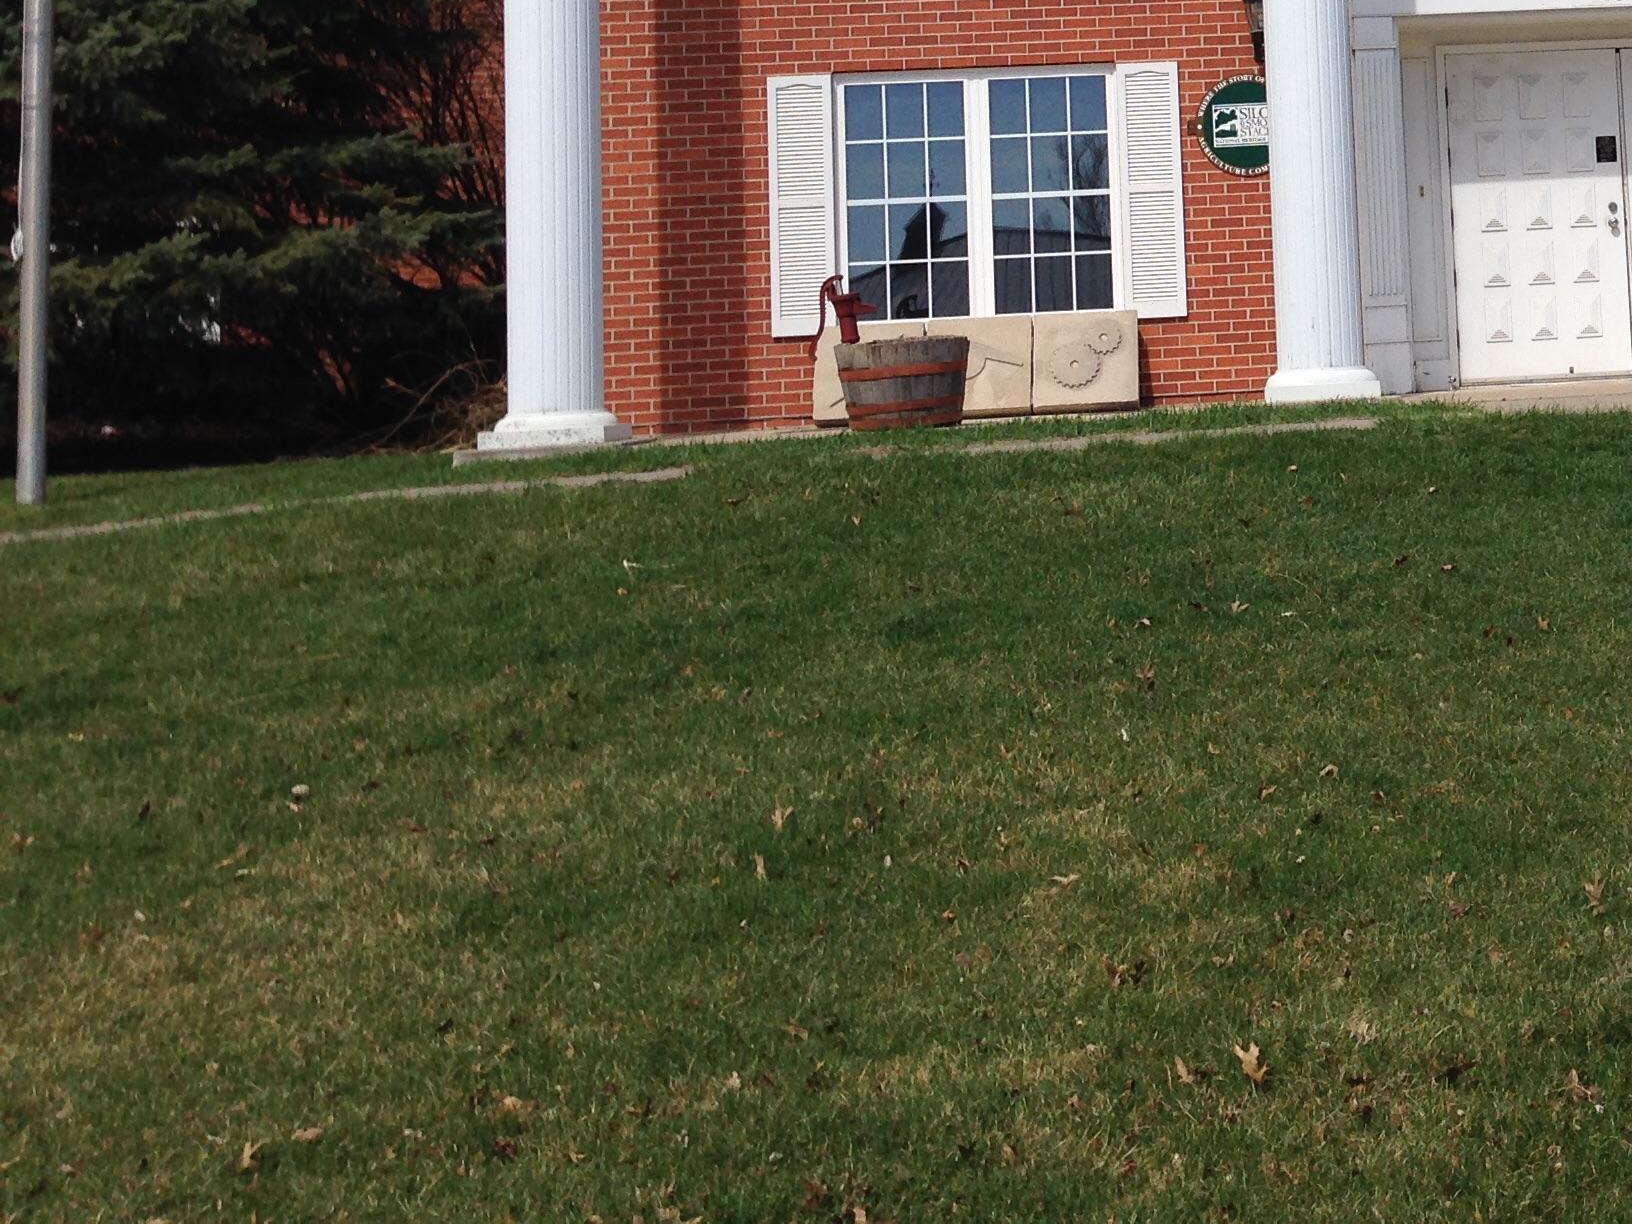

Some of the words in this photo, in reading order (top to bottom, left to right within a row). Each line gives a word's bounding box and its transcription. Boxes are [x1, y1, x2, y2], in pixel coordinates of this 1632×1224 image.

[1197, 91, 1214, 117] WHERE
[1213, 80, 1229, 92] THE
[1228, 74, 1253, 84] STORY
[1240, 127, 1269, 137] STAC
[1245, 119, 1268, 128] SMO
[1198, 137, 1247, 175] AGRICULTURE
[1248, 163, 1270, 174] COM
